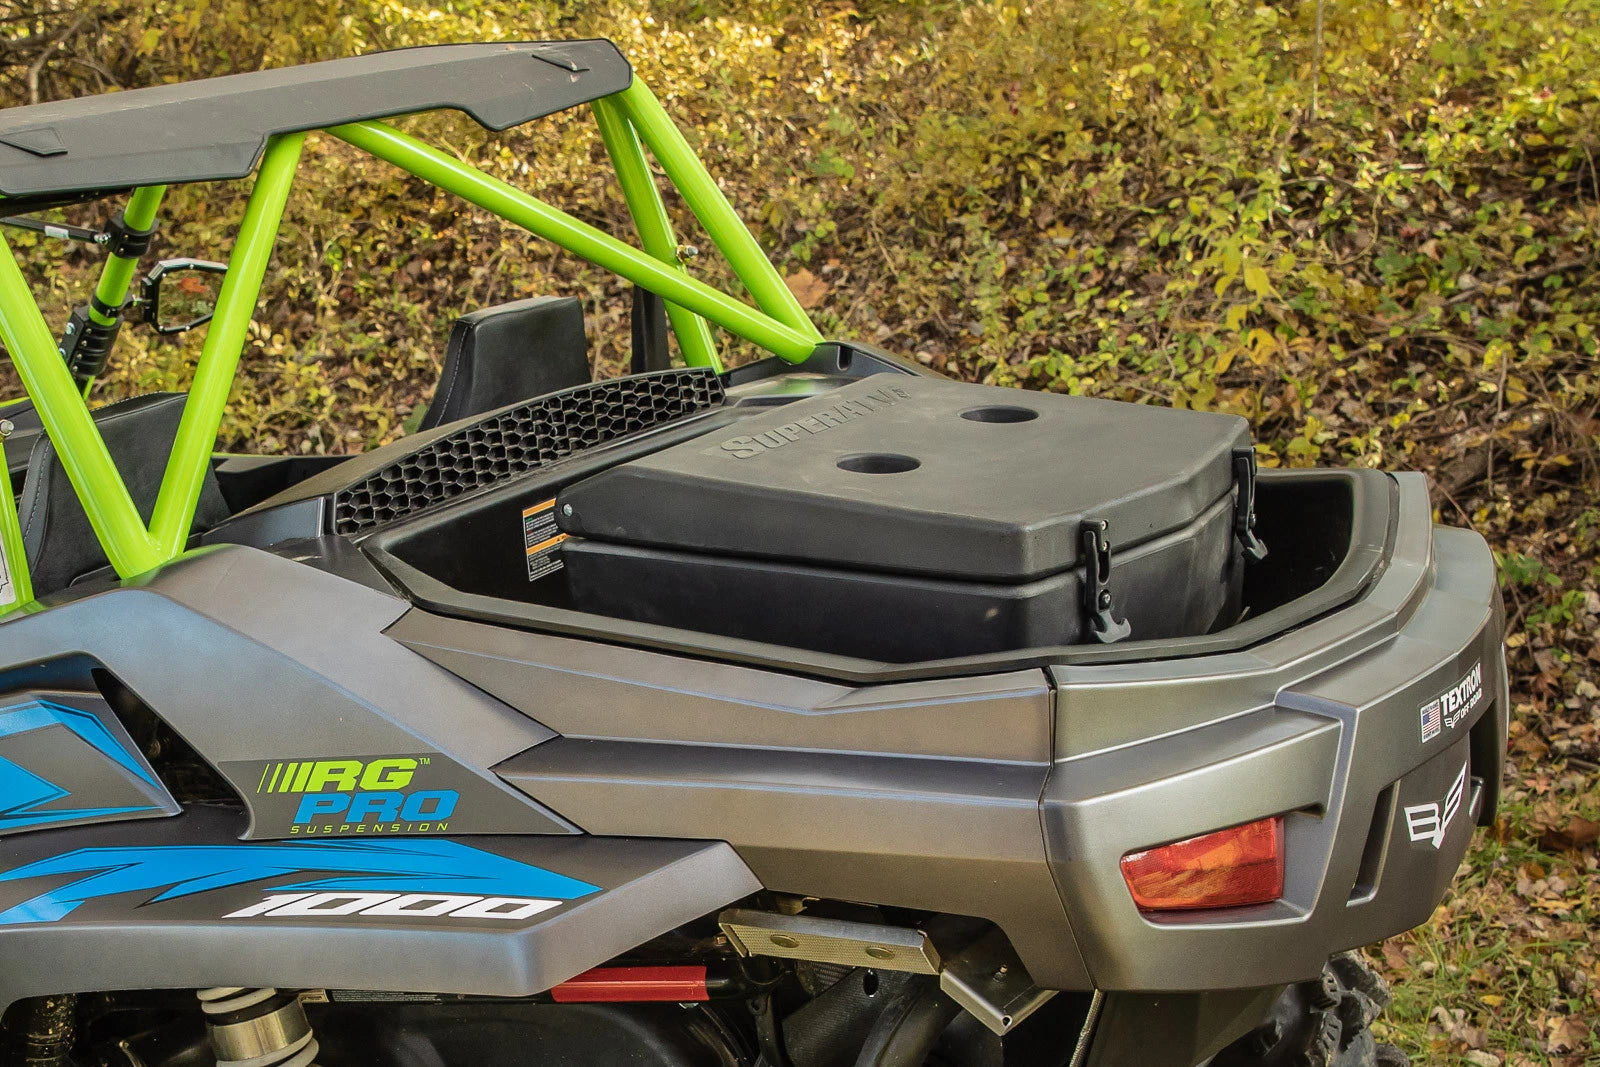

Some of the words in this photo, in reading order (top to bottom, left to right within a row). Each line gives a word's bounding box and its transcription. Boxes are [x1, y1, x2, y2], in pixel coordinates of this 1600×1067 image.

[1441, 662, 1481, 716] TEXTRON
[293, 789, 460, 824] PRO
[290, 823, 449, 834] SUSPENSION
[221, 892, 563, 920] 1000
